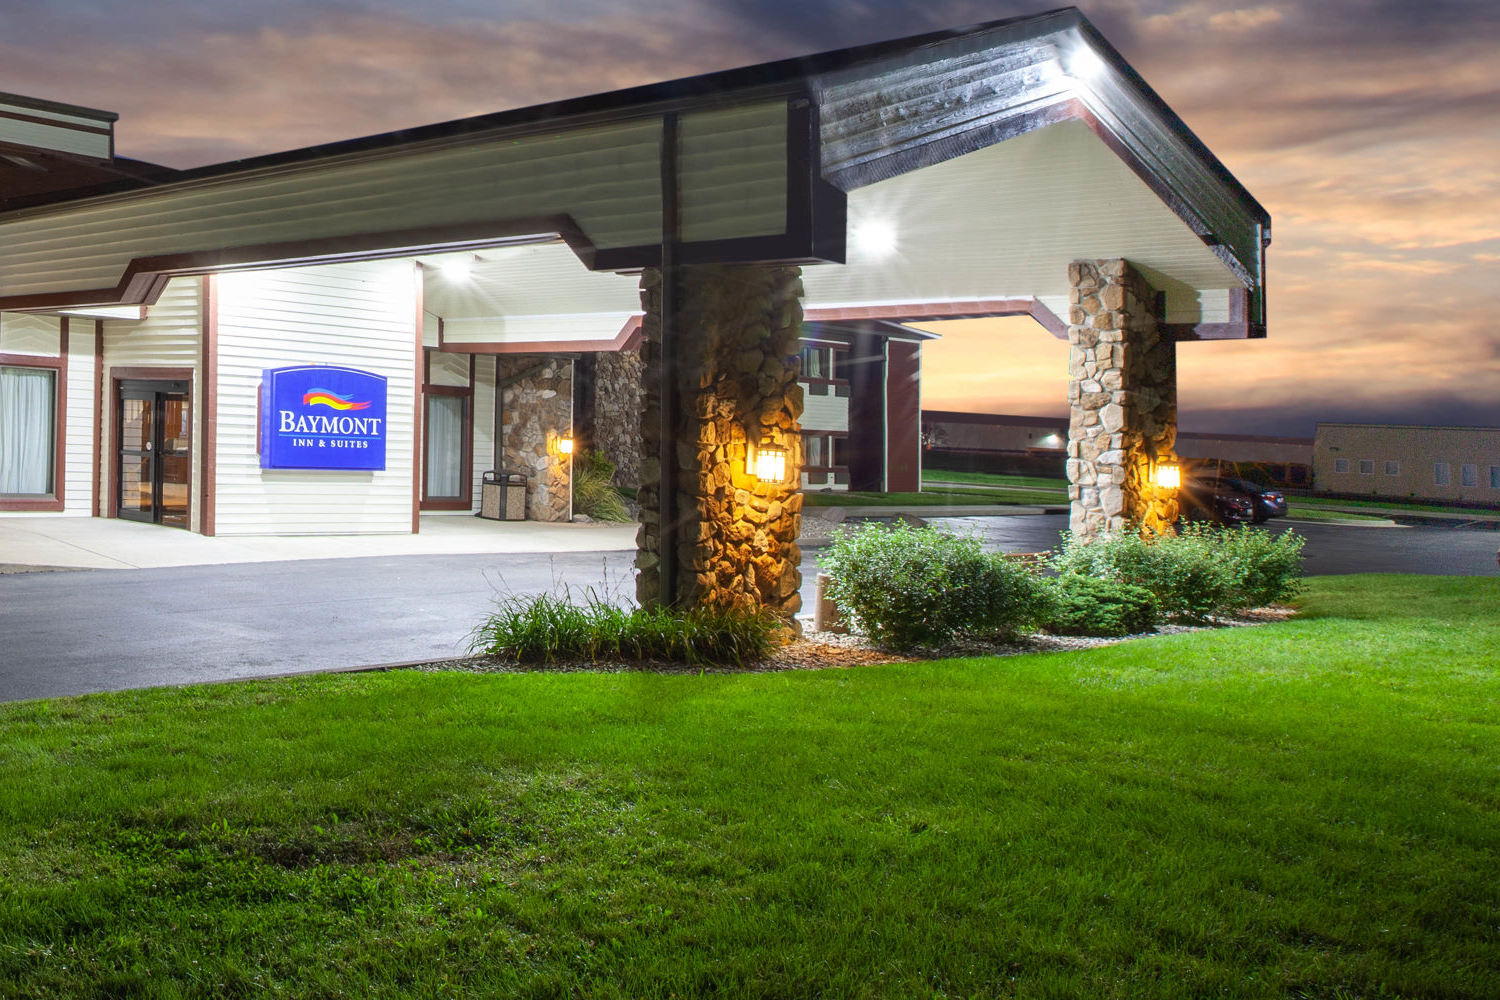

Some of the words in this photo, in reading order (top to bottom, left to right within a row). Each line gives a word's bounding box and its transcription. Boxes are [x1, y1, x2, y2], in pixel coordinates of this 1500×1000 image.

[279, 410, 381, 435] BAYMONT
[293, 438, 314, 447] INN
[318, 439, 326, 448] &
[330, 439, 368, 449] SUITES
